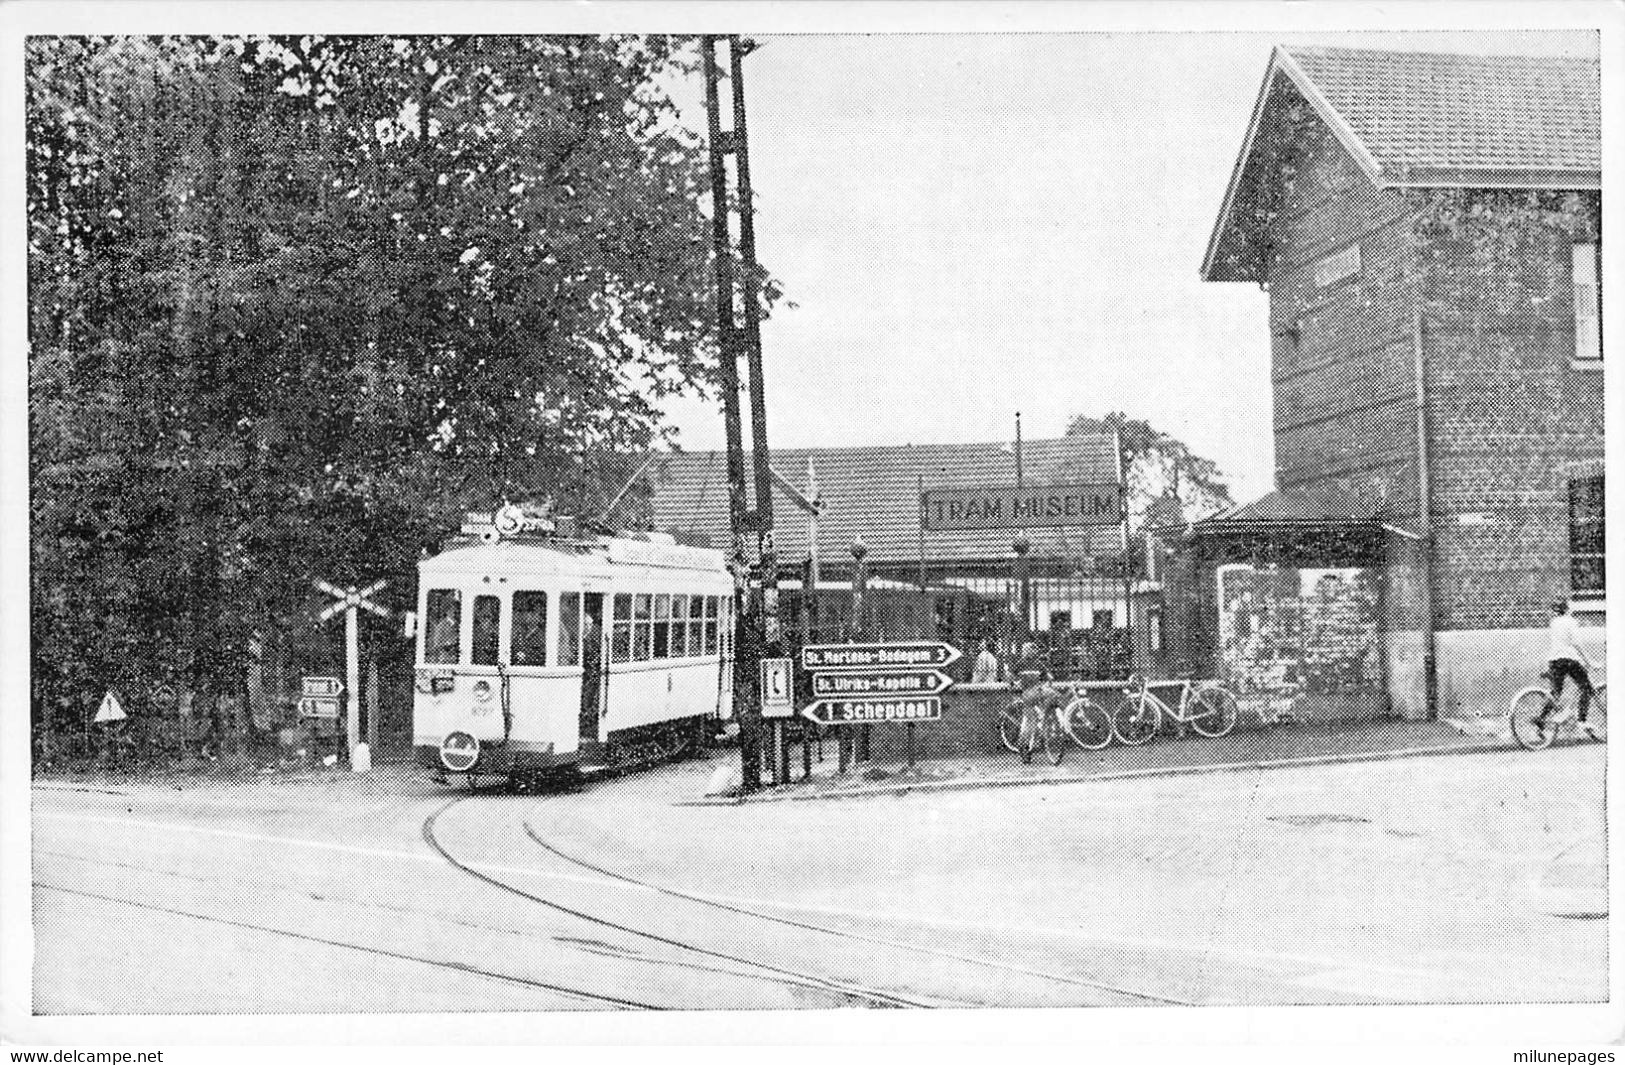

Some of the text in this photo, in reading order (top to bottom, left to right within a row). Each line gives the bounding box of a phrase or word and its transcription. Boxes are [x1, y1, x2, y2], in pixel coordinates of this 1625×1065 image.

[932, 494, 1114, 521] TRAM MUSEUM
[843, 701, 931, 720] Schepdaal
